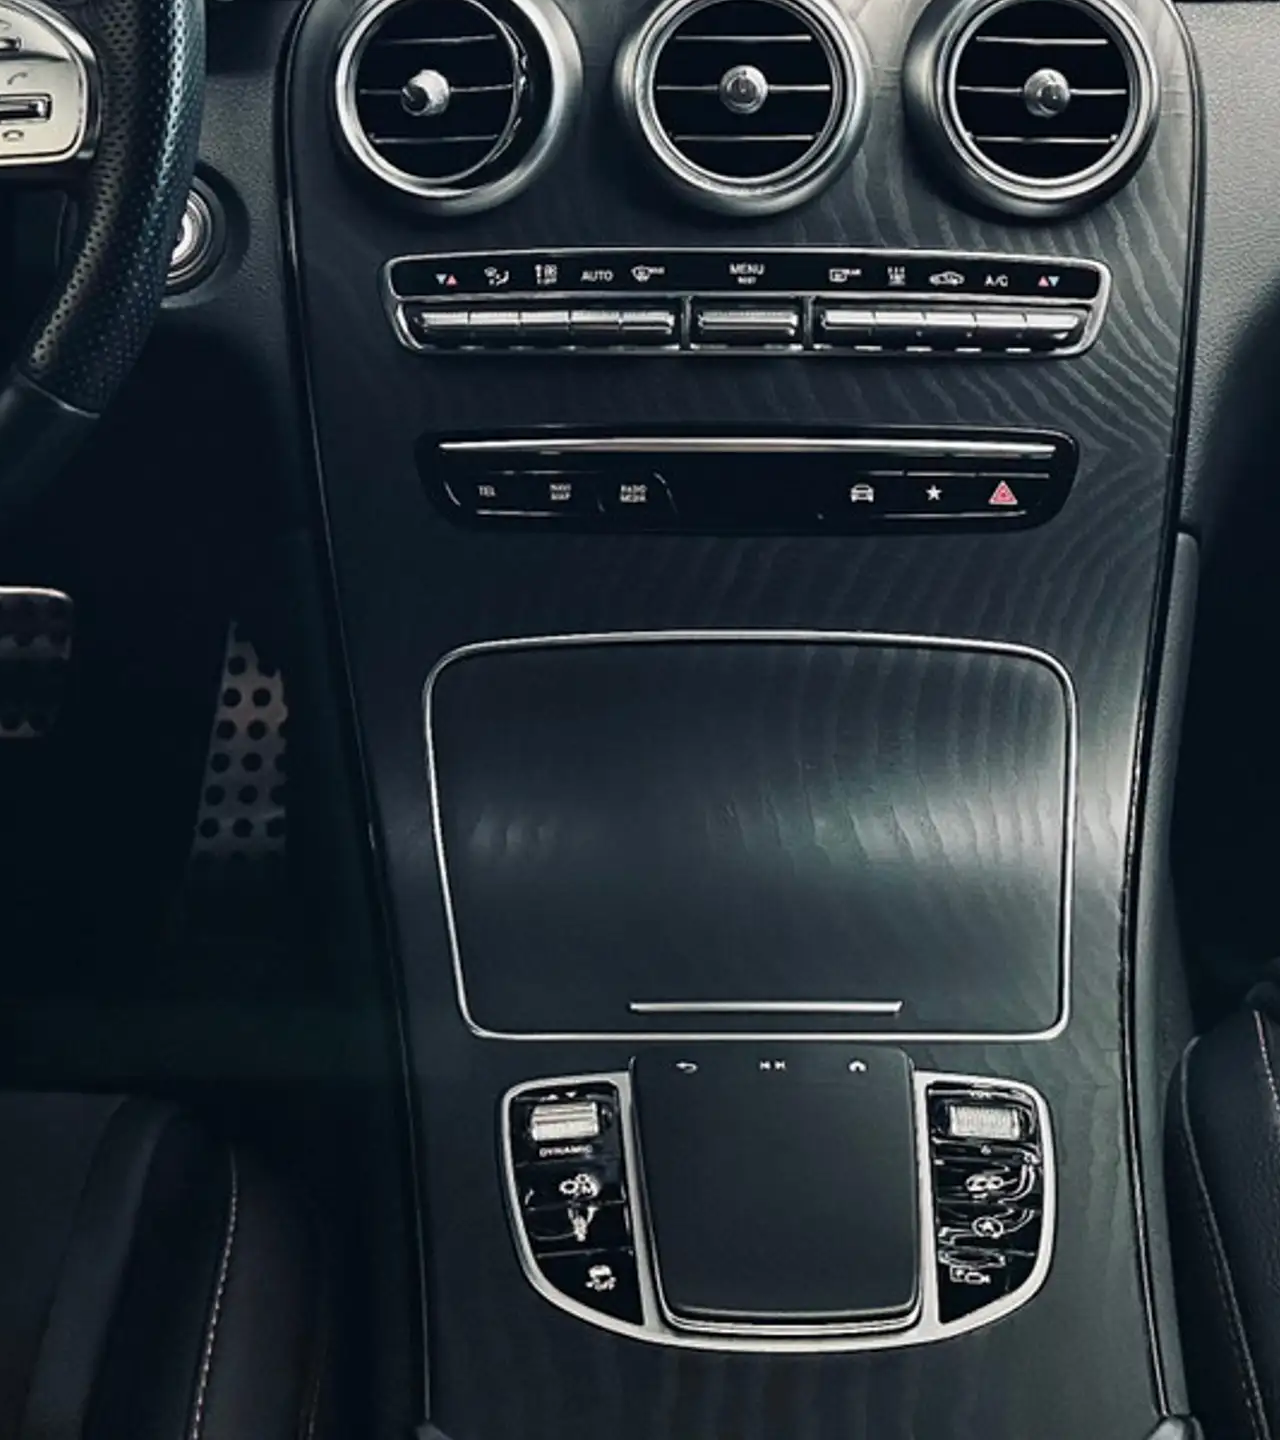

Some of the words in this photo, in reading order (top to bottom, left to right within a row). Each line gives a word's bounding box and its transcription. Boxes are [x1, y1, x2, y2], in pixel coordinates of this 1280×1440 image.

[729, 263, 766, 276] MENU
[580, 270, 614, 283] AUTO
[983, 274, 1009, 288] A/C
